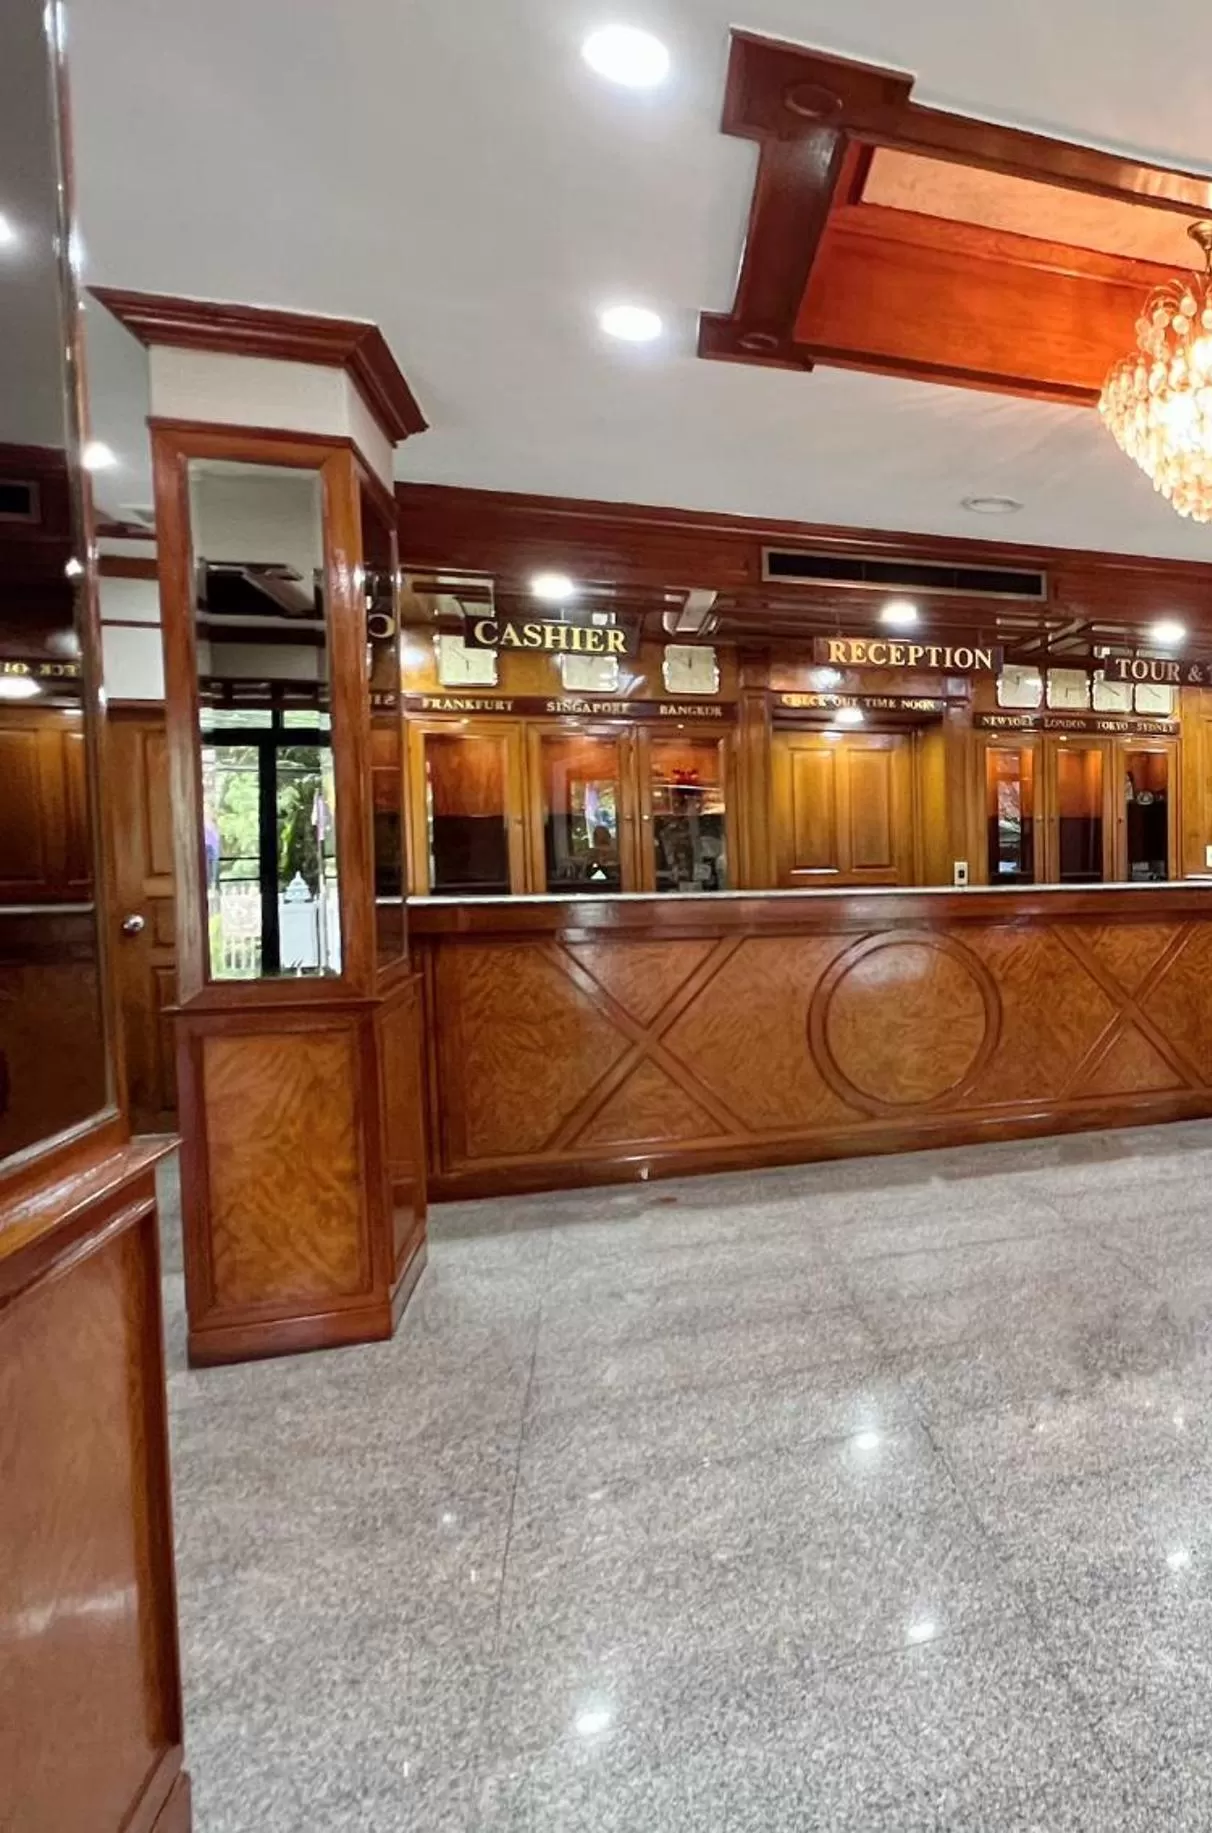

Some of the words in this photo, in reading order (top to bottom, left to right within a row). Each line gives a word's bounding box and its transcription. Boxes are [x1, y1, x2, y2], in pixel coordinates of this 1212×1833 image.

[474, 620, 627, 653] CASHIER
[828, 640, 993, 670] RECEPTION
[1116, 658, 1180, 681] TOUR
[1187, 664, 1202, 682] &
[421, 697, 514, 711] FRANKFURT
[546, 700, 630, 714] SINGAPORE
[865, 698, 896, 709] TIME
[659, 705, 722, 717] BANGKOK
[1043, 718, 1087, 730] LONDON
[1096, 721, 1128, 731] TOKYO
[1136, 722, 1175, 734] SYDNEY
